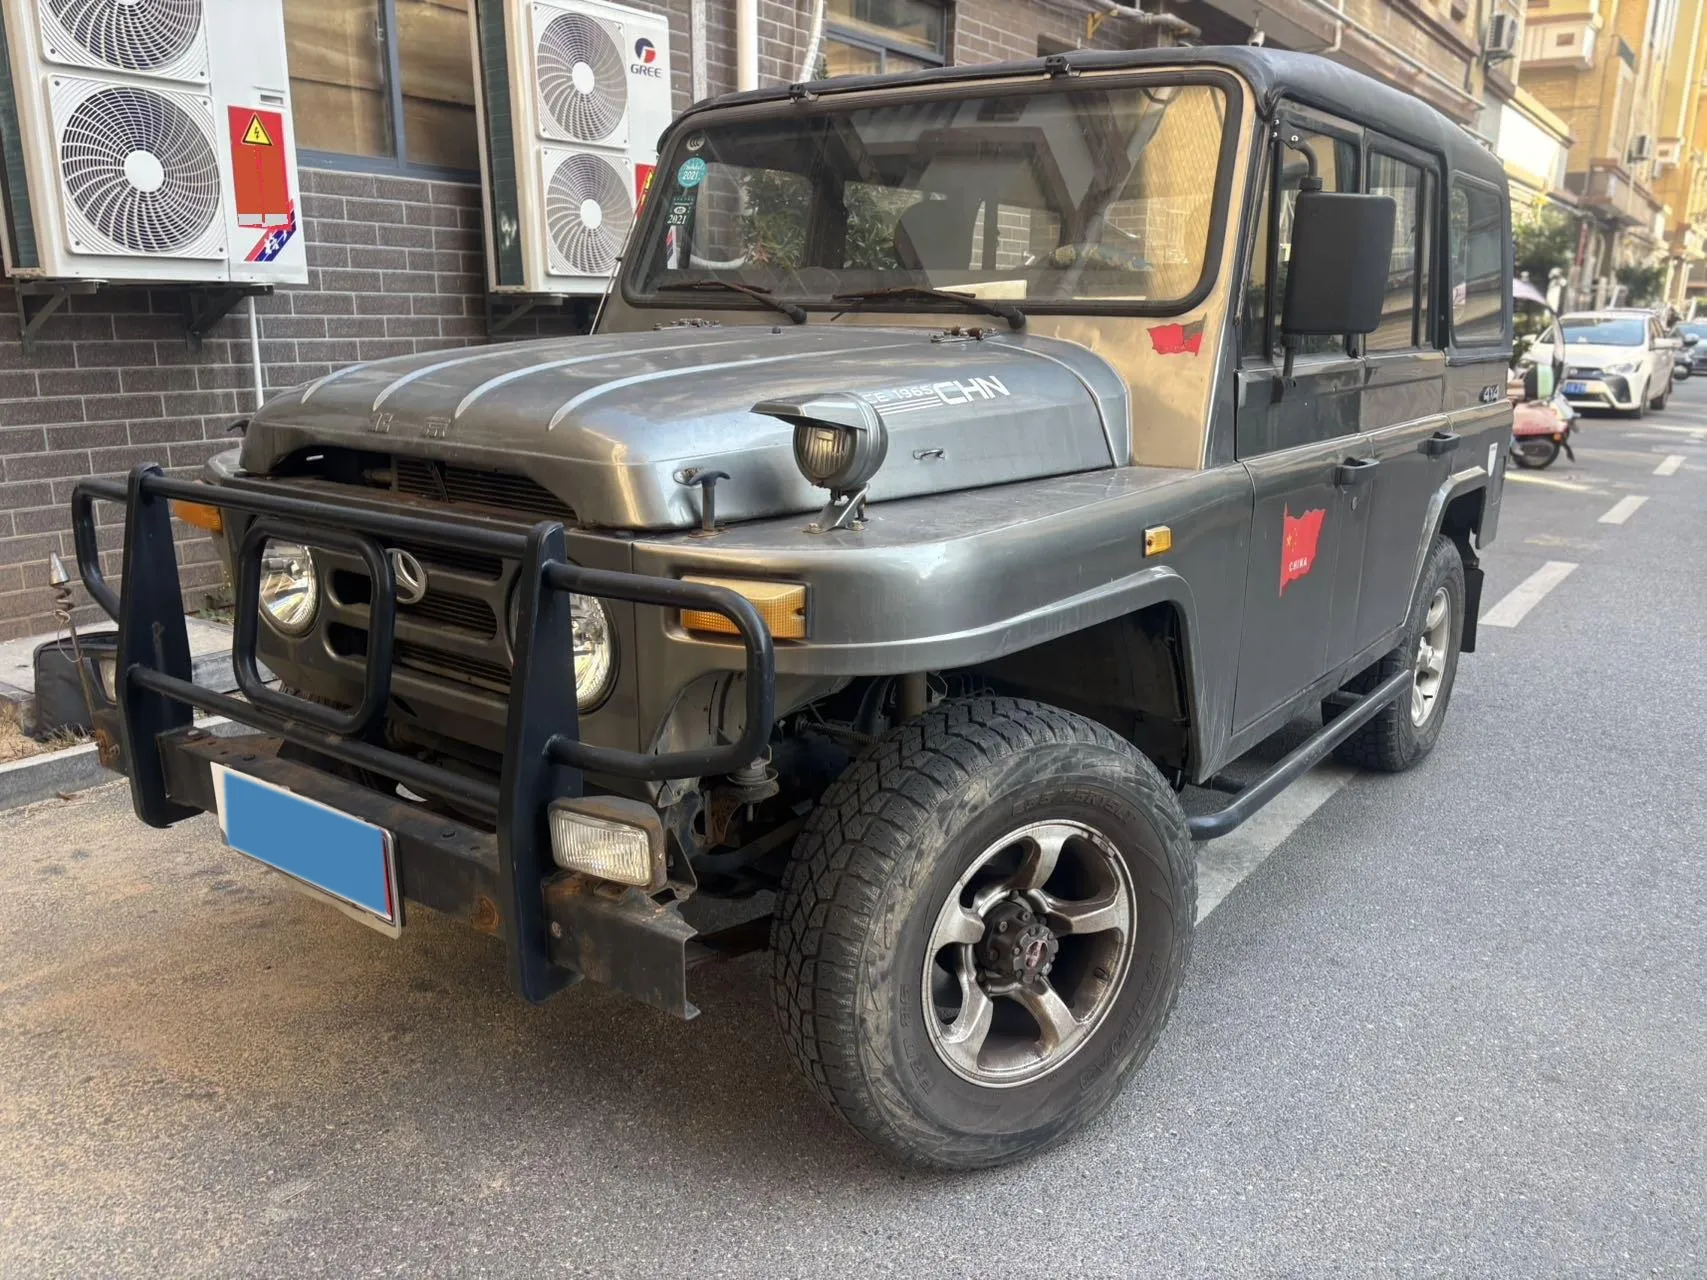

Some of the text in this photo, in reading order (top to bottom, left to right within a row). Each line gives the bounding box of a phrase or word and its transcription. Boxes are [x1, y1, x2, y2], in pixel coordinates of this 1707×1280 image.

[630, 64, 662, 79] GREE
[682, 170, 699, 180] 2021
[667, 214, 687, 225] 2021
[893, 384, 933, 400] 1965
[933, 375, 1010, 405] CHN
[1288, 556, 1308, 573] CHINA
